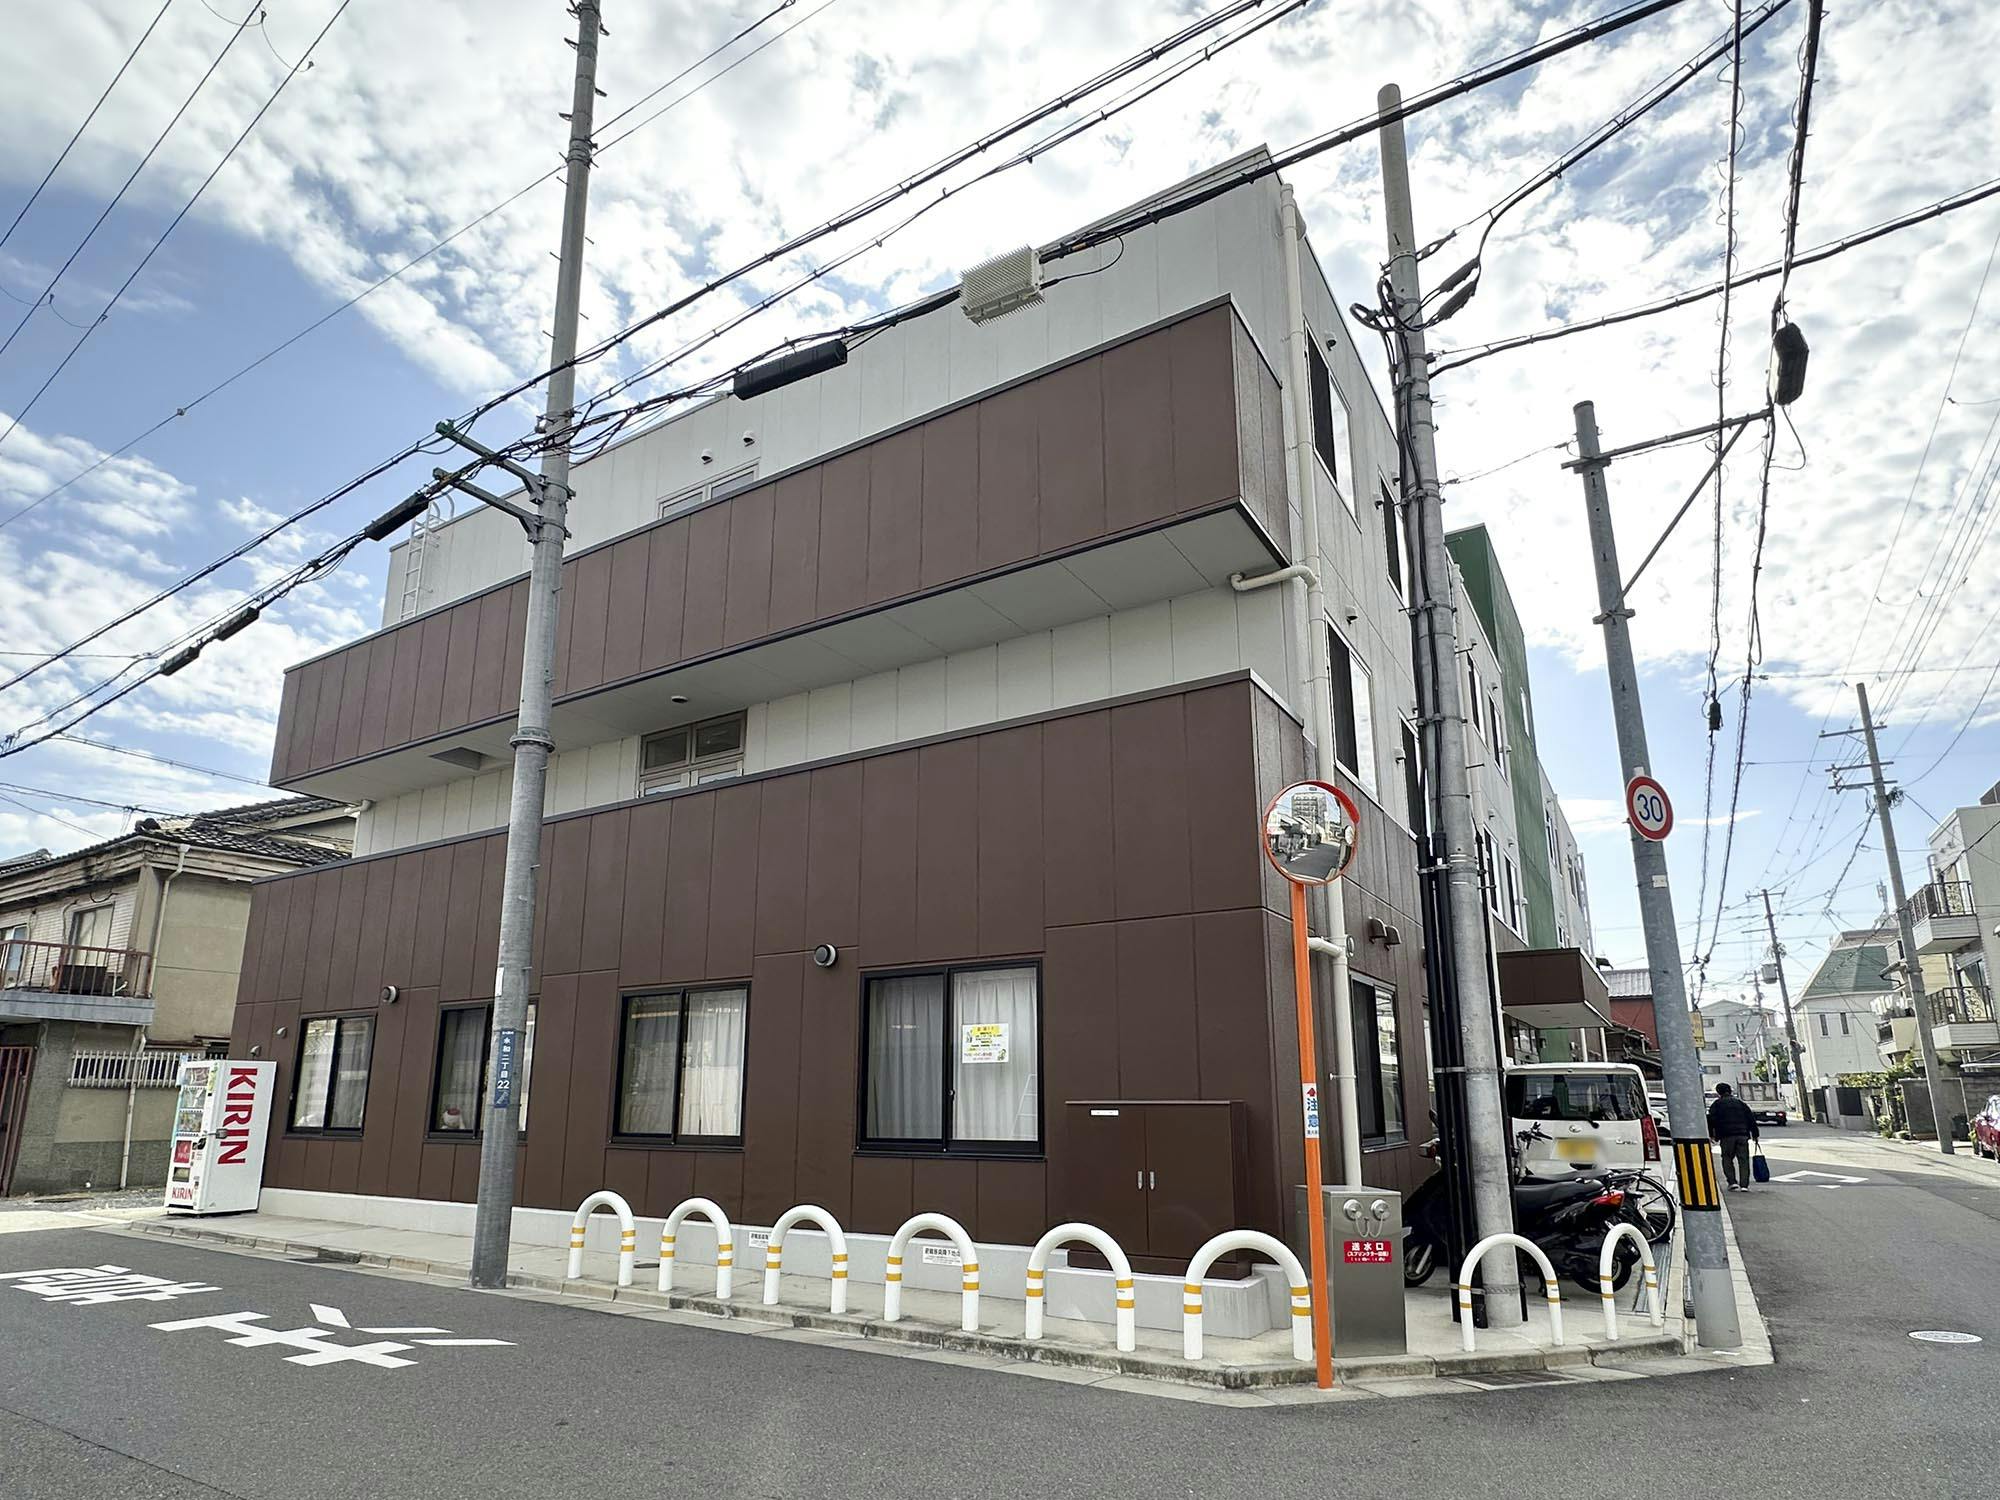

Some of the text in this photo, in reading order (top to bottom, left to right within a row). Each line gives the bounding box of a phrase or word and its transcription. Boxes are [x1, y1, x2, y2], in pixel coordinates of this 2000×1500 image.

[1637, 794, 1664, 822] 30
[496, 1080, 510, 1089] 22
[217, 1067, 258, 1165] KIRIN
[1306, 1097, 1319, 1128] 注意
[171, 1187, 193, 1200] KIRIN
